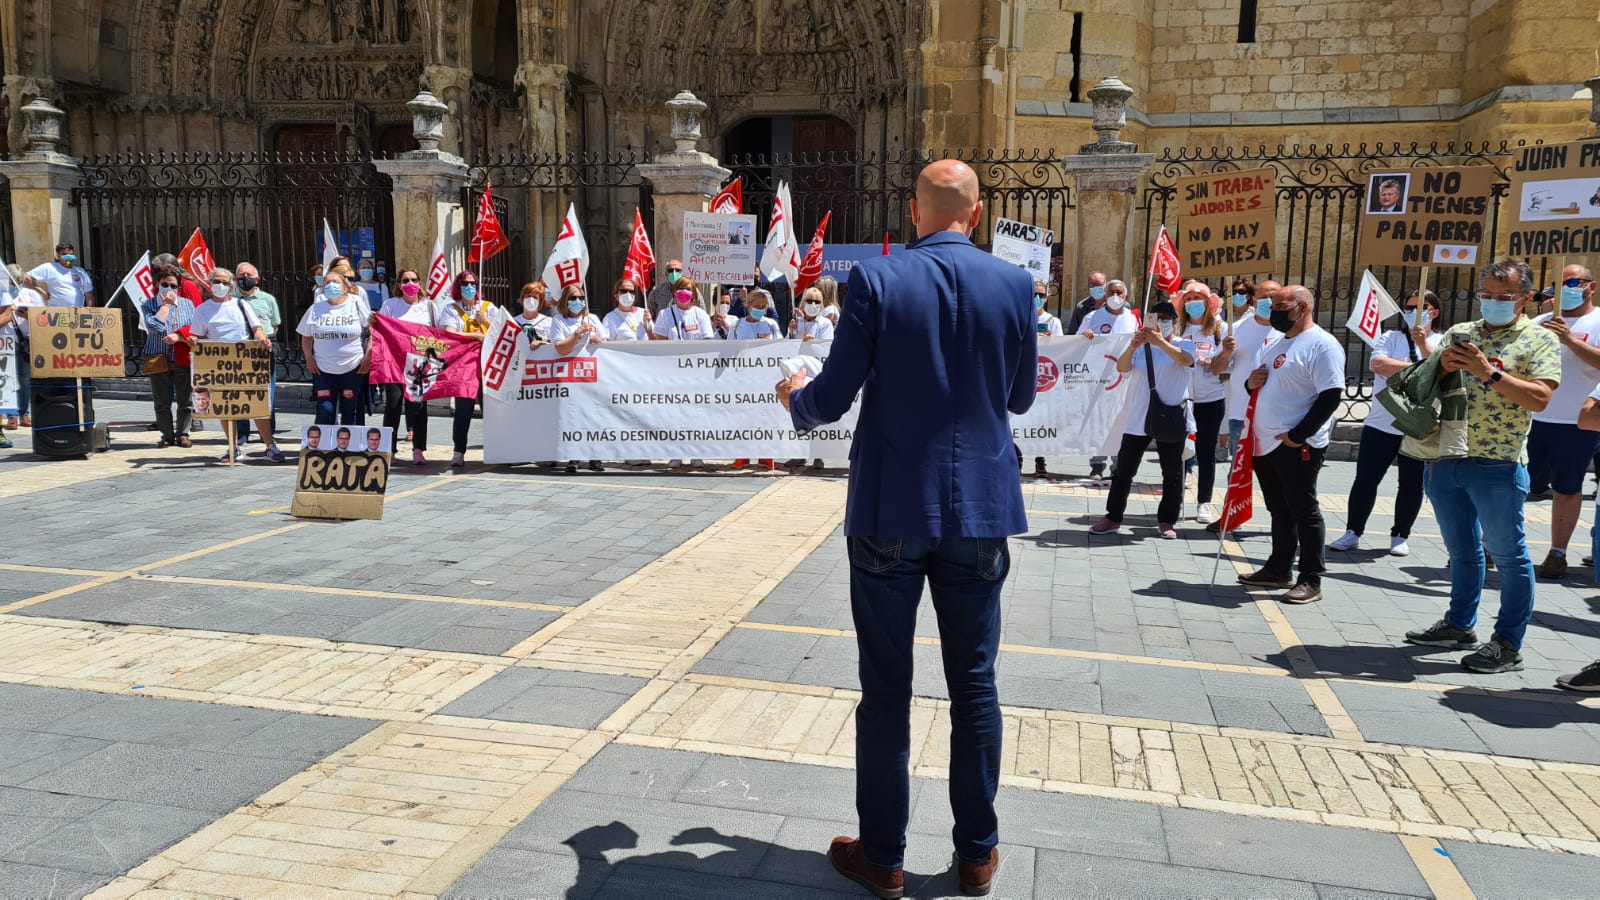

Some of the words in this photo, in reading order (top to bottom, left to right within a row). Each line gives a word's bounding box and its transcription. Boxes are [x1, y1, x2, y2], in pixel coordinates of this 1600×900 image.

[1515, 146, 1568, 171] JUAN
[1185, 181, 1209, 201] SIN
[1423, 171, 1461, 194] NO
[1190, 195, 1262, 216] JADORES
[1408, 196, 1486, 215] TIENES
[1188, 226, 1211, 242] NO
[1223, 221, 1259, 241] HAY
[1376, 219, 1482, 243] PALABRA
[689, 255, 726, 265] AHORA
[1190, 241, 1270, 269] EMPRESA
[1402, 244, 1430, 262] NI
[688, 267, 701, 281] YA
[704, 270, 715, 281] NO
[36, 310, 115, 329] OVEJERO
[52, 332, 68, 350] O
[75, 329, 104, 350] TÚ
[34, 354, 45, 369] O
[217, 360, 243, 371] PON
[678, 358, 693, 369] LA
[697, 357, 763, 369] PLANTILLA
[1063, 363, 1090, 374] FICA
[221, 390, 240, 401] EN
[612, 393, 629, 404] EN
[633, 393, 690, 404] DEFENSA
[694, 393, 711, 404] DE
[714, 393, 731, 404] SU
[735, 393, 779, 404] SALARI
[562, 430, 582, 442] NO
[586, 428, 617, 442] MÁS
[620, 427, 772, 442] DESINDUSTRIALIZACIÓN
[777, 430, 785, 441] Y
[1023, 425, 1057, 439] LEÓN
[302, 452, 388, 494] RATA
